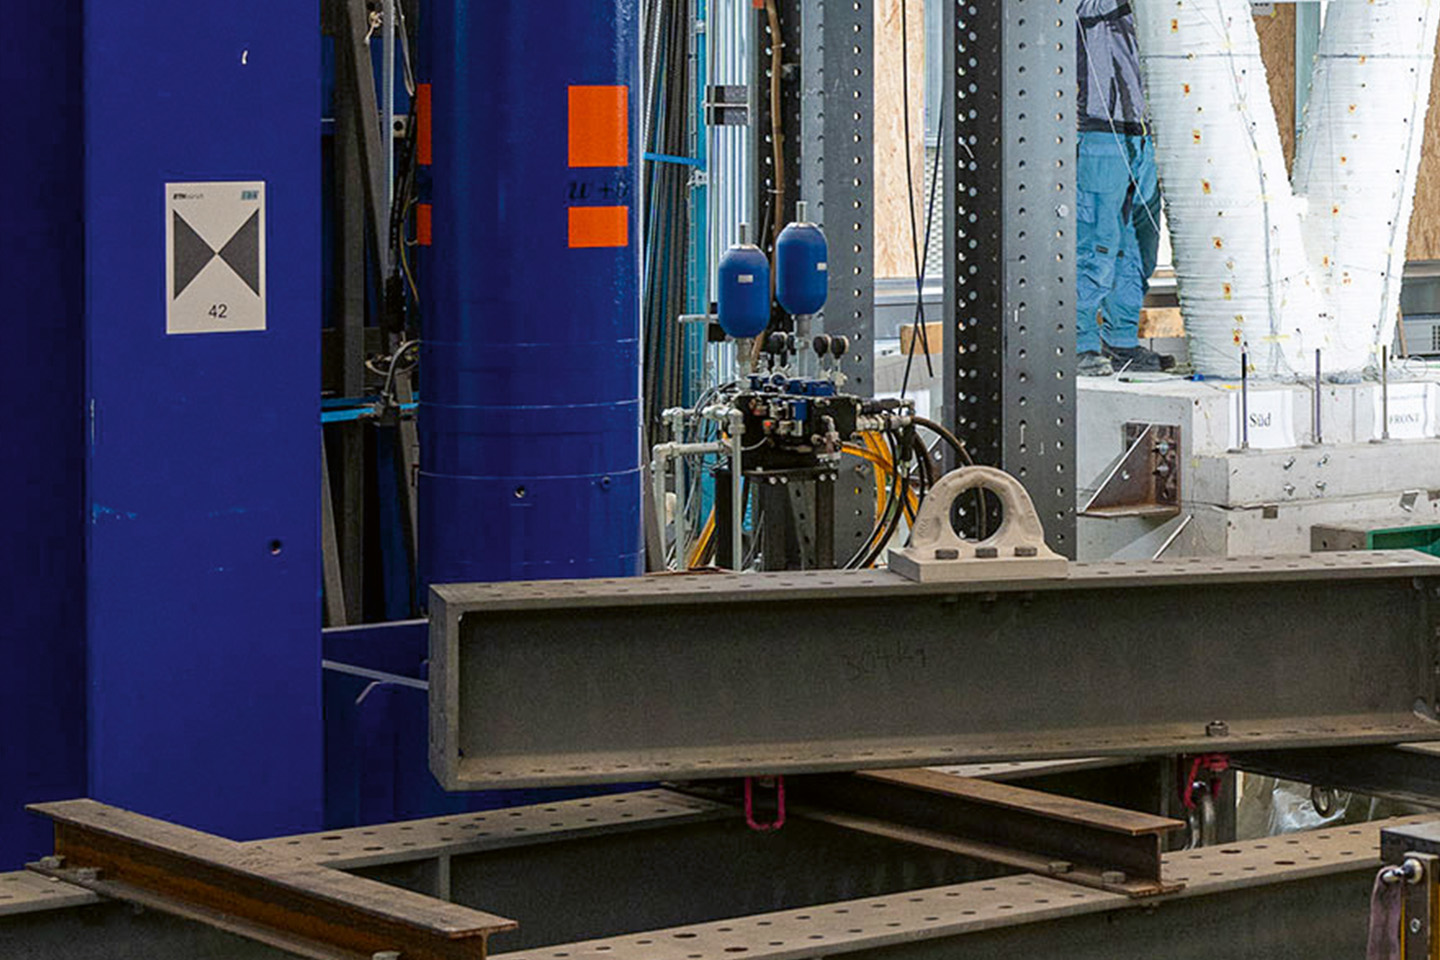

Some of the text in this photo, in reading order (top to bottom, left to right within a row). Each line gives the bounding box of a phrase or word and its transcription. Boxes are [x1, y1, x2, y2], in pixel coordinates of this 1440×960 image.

[208, 303, 228, 319] 42
[1249, 412, 1272, 428] Süd
[1388, 412, 1420, 425] FRONT
